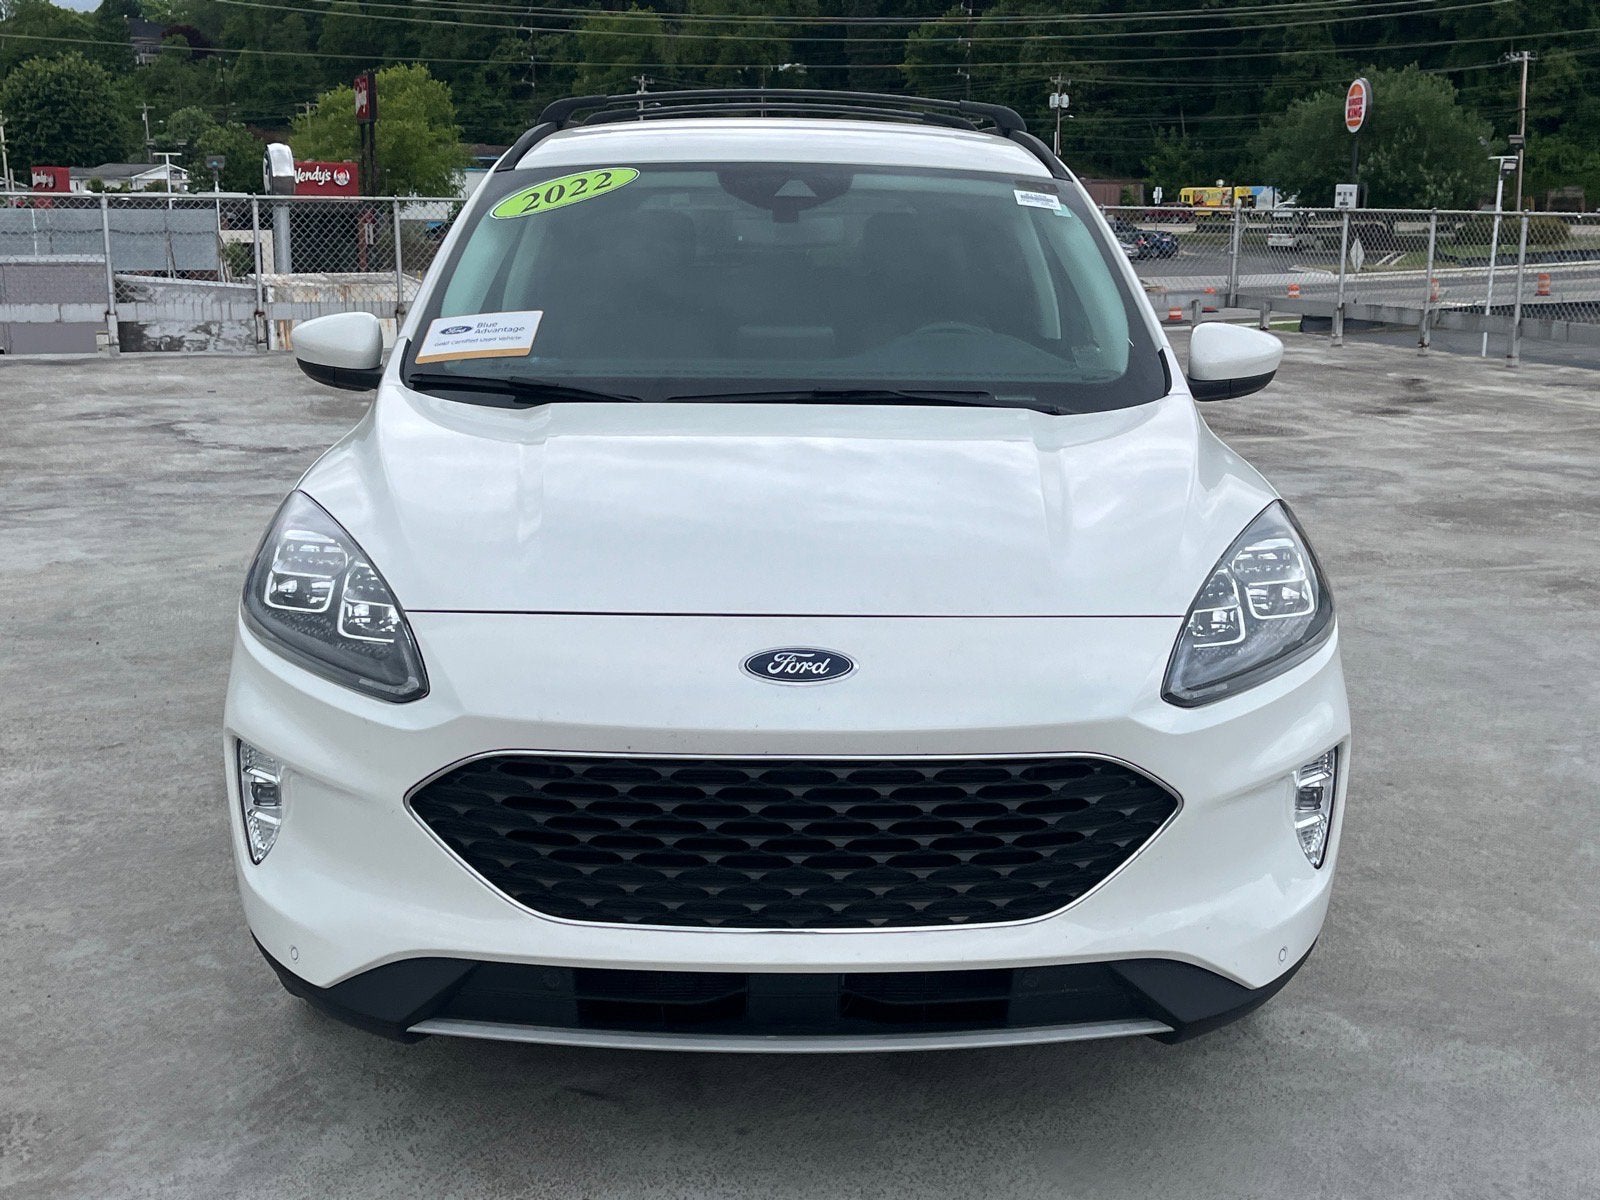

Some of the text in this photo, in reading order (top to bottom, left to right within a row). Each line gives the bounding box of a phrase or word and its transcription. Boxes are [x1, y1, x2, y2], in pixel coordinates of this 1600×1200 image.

[1347, 106, 1363, 119] KING
[520, 172, 613, 213] 2022
[474, 326, 525, 334] Advantage
[476, 321, 498, 329] Blue
[767, 652, 831, 675] Ford
